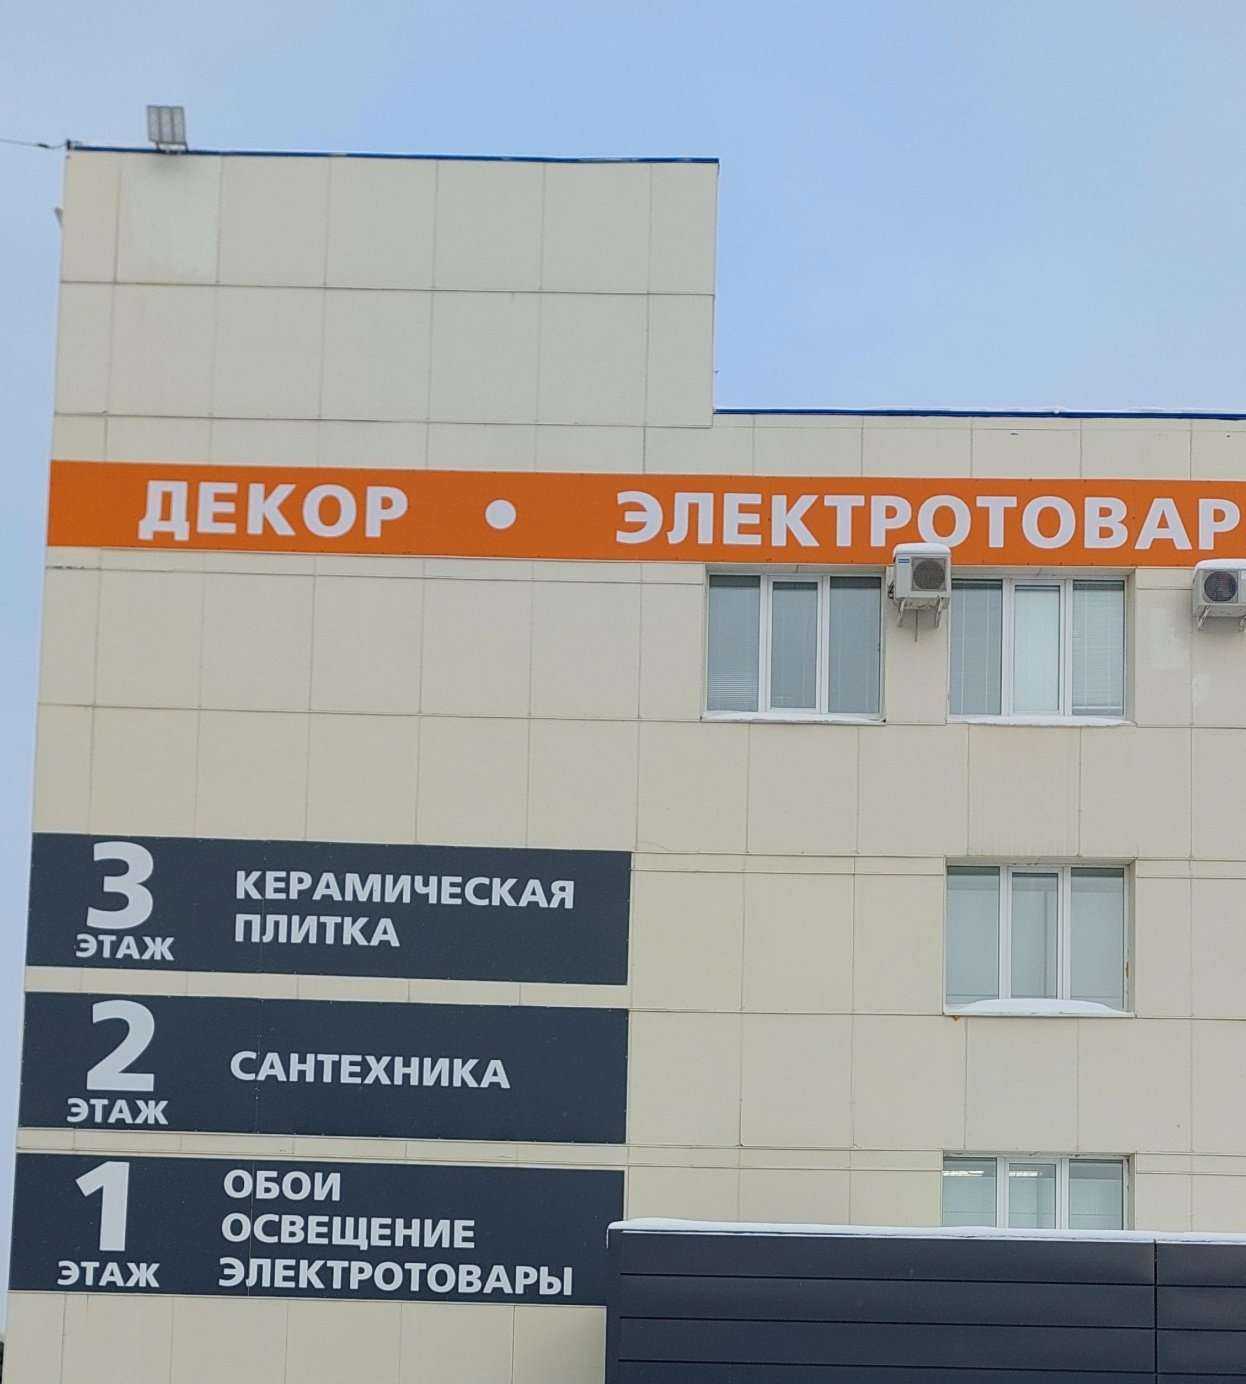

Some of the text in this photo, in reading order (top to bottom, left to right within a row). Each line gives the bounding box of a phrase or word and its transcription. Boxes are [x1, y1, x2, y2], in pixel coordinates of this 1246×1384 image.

[138, 481, 1240, 551] ДЕКОР ЭЛЕКТРОТОВАР
[86, 841, 154, 928] 3
[235, 869, 575, 909] КЕРАМИЧЕСКАЯ
[75, 934, 175, 962] ЭТАЖ
[234, 914, 401, 948] ПЛИТКА
[86, 1000, 155, 1091] 2
[230, 1051, 511, 1089] САНТЕХНИКА
[66, 1097, 169, 1125] ЭТАЖ
[223, 1169, 342, 1202] ОБОИ
[75, 1161, 130, 1252] 1
[221, 1213, 476, 1251] ОСВЕЩЕНИЕ
[57, 1261, 160, 1288] ЭТАЖ
[218, 1257, 574, 1297] ЭЛЕКТРОТОВАРЫ
